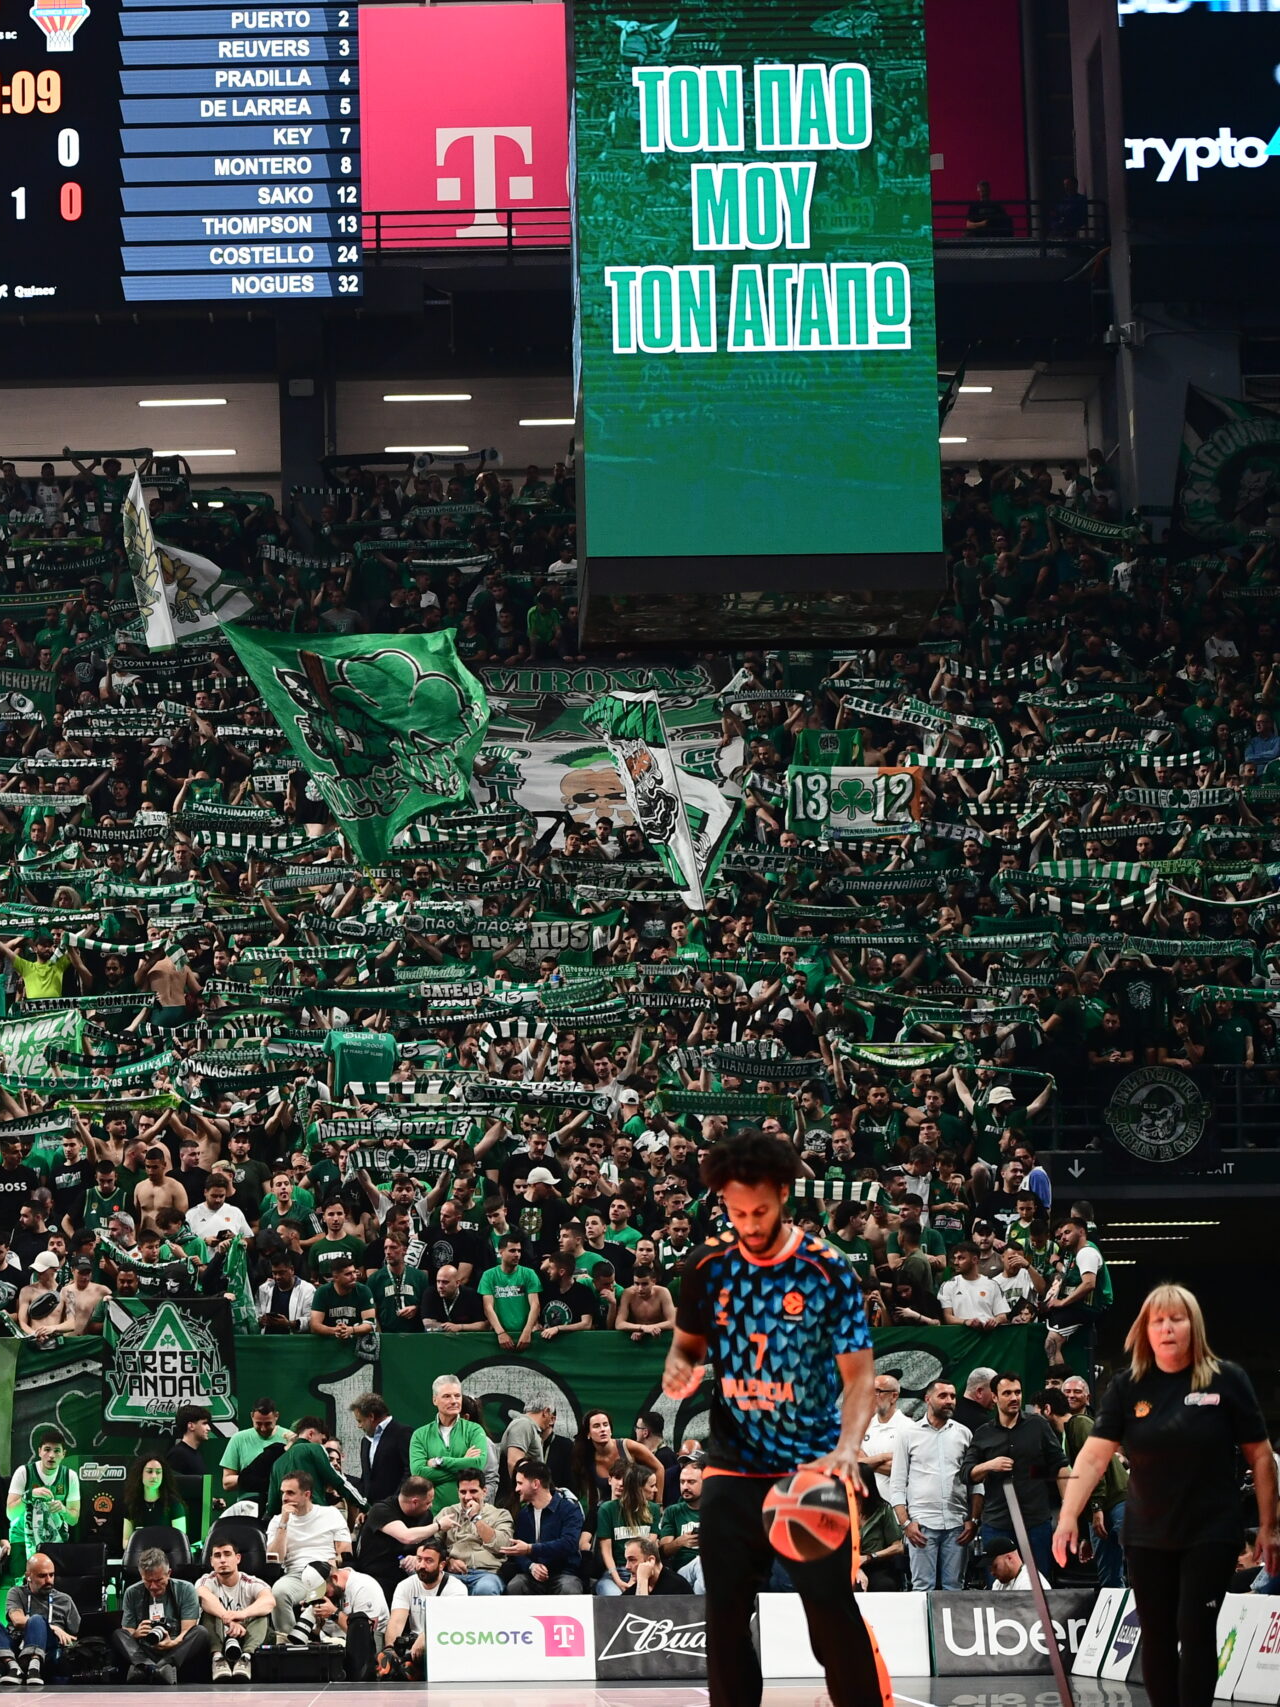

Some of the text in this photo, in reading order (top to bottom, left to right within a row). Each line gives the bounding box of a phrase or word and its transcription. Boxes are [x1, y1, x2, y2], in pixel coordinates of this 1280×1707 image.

[231, 10, 350, 29] PUERTO 2
[5, 31, 18, 41] BC
[219, 40, 350, 58] REUVERS 3
[215, 69, 351, 87] PRADILLA 4
[200, 98, 351, 117] DE LARREA 5
[632, 62, 871, 153] ΤΟΝ ΠΑΟ
[273, 128, 351, 145] KEY 7
[57, 128, 80, 167] 0
[214, 157, 352, 175] MONTERO 8
[10, 186, 26, 220] 1
[60, 182, 82, 221] 0
[258, 186, 357, 204] SAKO 12
[691, 162, 816, 251] ΜΟΥ
[202, 216, 358, 235] THOMPSON 13
[210, 245, 359, 264] COSTELLO 24
[231, 275, 359, 293] NOGUES 32
[605, 264, 718, 354] ΤΟΝ
[484, 665, 712, 695] VIRONAS
[845, 696, 893, 717] GREEN
[793, 770, 914, 823] 13 12
[192, 801, 271, 819] PANATHINAIKOS
[1078, 822, 1164, 840] PANATHINAIKOS
[108, 881, 196, 899] NAFPLIO
[9, 917, 35, 927] CLUB
[51, 915, 67, 924] 40
[68, 911, 101, 922] YEARS
[833, 935, 905, 945] PANATHINAIKOS
[96, 995, 157, 1009] CONTRAC
[484, 1086, 591, 1106] ΠΑΟ ΠΑΟ
[320, 1120, 469, 1138] ΜΑΝΗ ΘΥΡΑ 13
[749, 1333, 768, 1371] 7
[119, 1350, 215, 1374] GREEN
[109, 1373, 228, 1398] VANDALS
[436, 1629, 533, 1647] COSMOTE
[941, 1606, 1086, 1657] Uber
